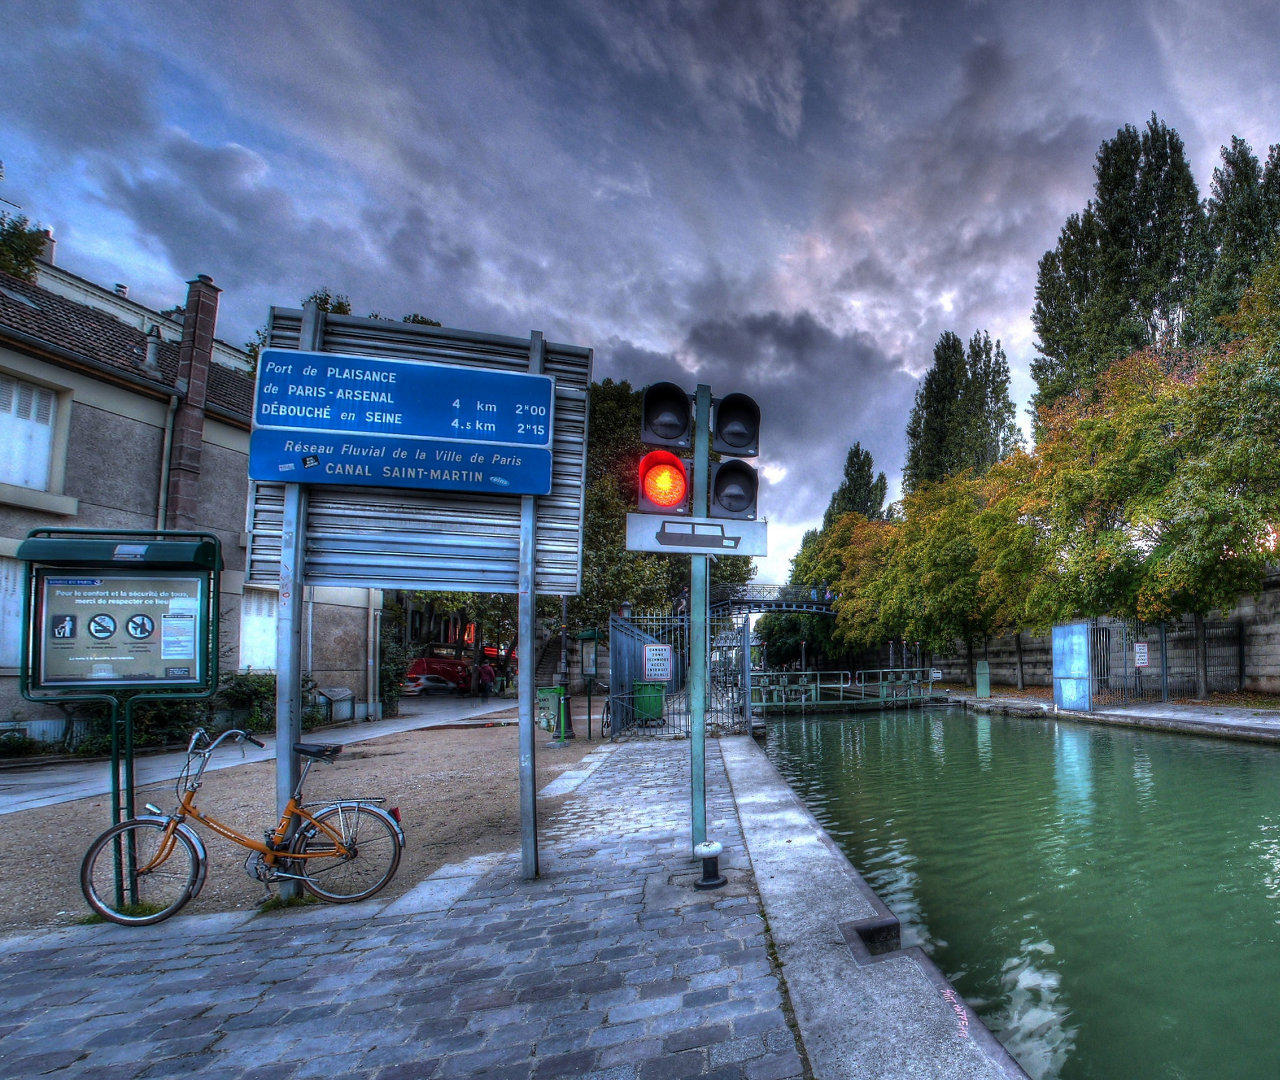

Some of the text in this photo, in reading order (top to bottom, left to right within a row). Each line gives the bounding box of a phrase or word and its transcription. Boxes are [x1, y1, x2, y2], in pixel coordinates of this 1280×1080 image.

[266, 362, 396, 383] Port de PLAISANCE
[263, 383, 279, 394] de
[452, 399, 460, 408] 4
[477, 401, 497, 412] km
[261, 401, 331, 419] DÉBOUCHÉ
[340, 412, 356, 420] en
[365, 412, 402, 424] SEINE
[475, 420, 496, 431] km
[284, 440, 522, 466] Réseau Fluvial de la Ville de Paris
[325, 462, 372, 476] CANAL
[382, 466, 483, 482] SAINT-MARTIN
[109, 598, 143, 606] respecter
[129, 590, 158, 598] sécurité
